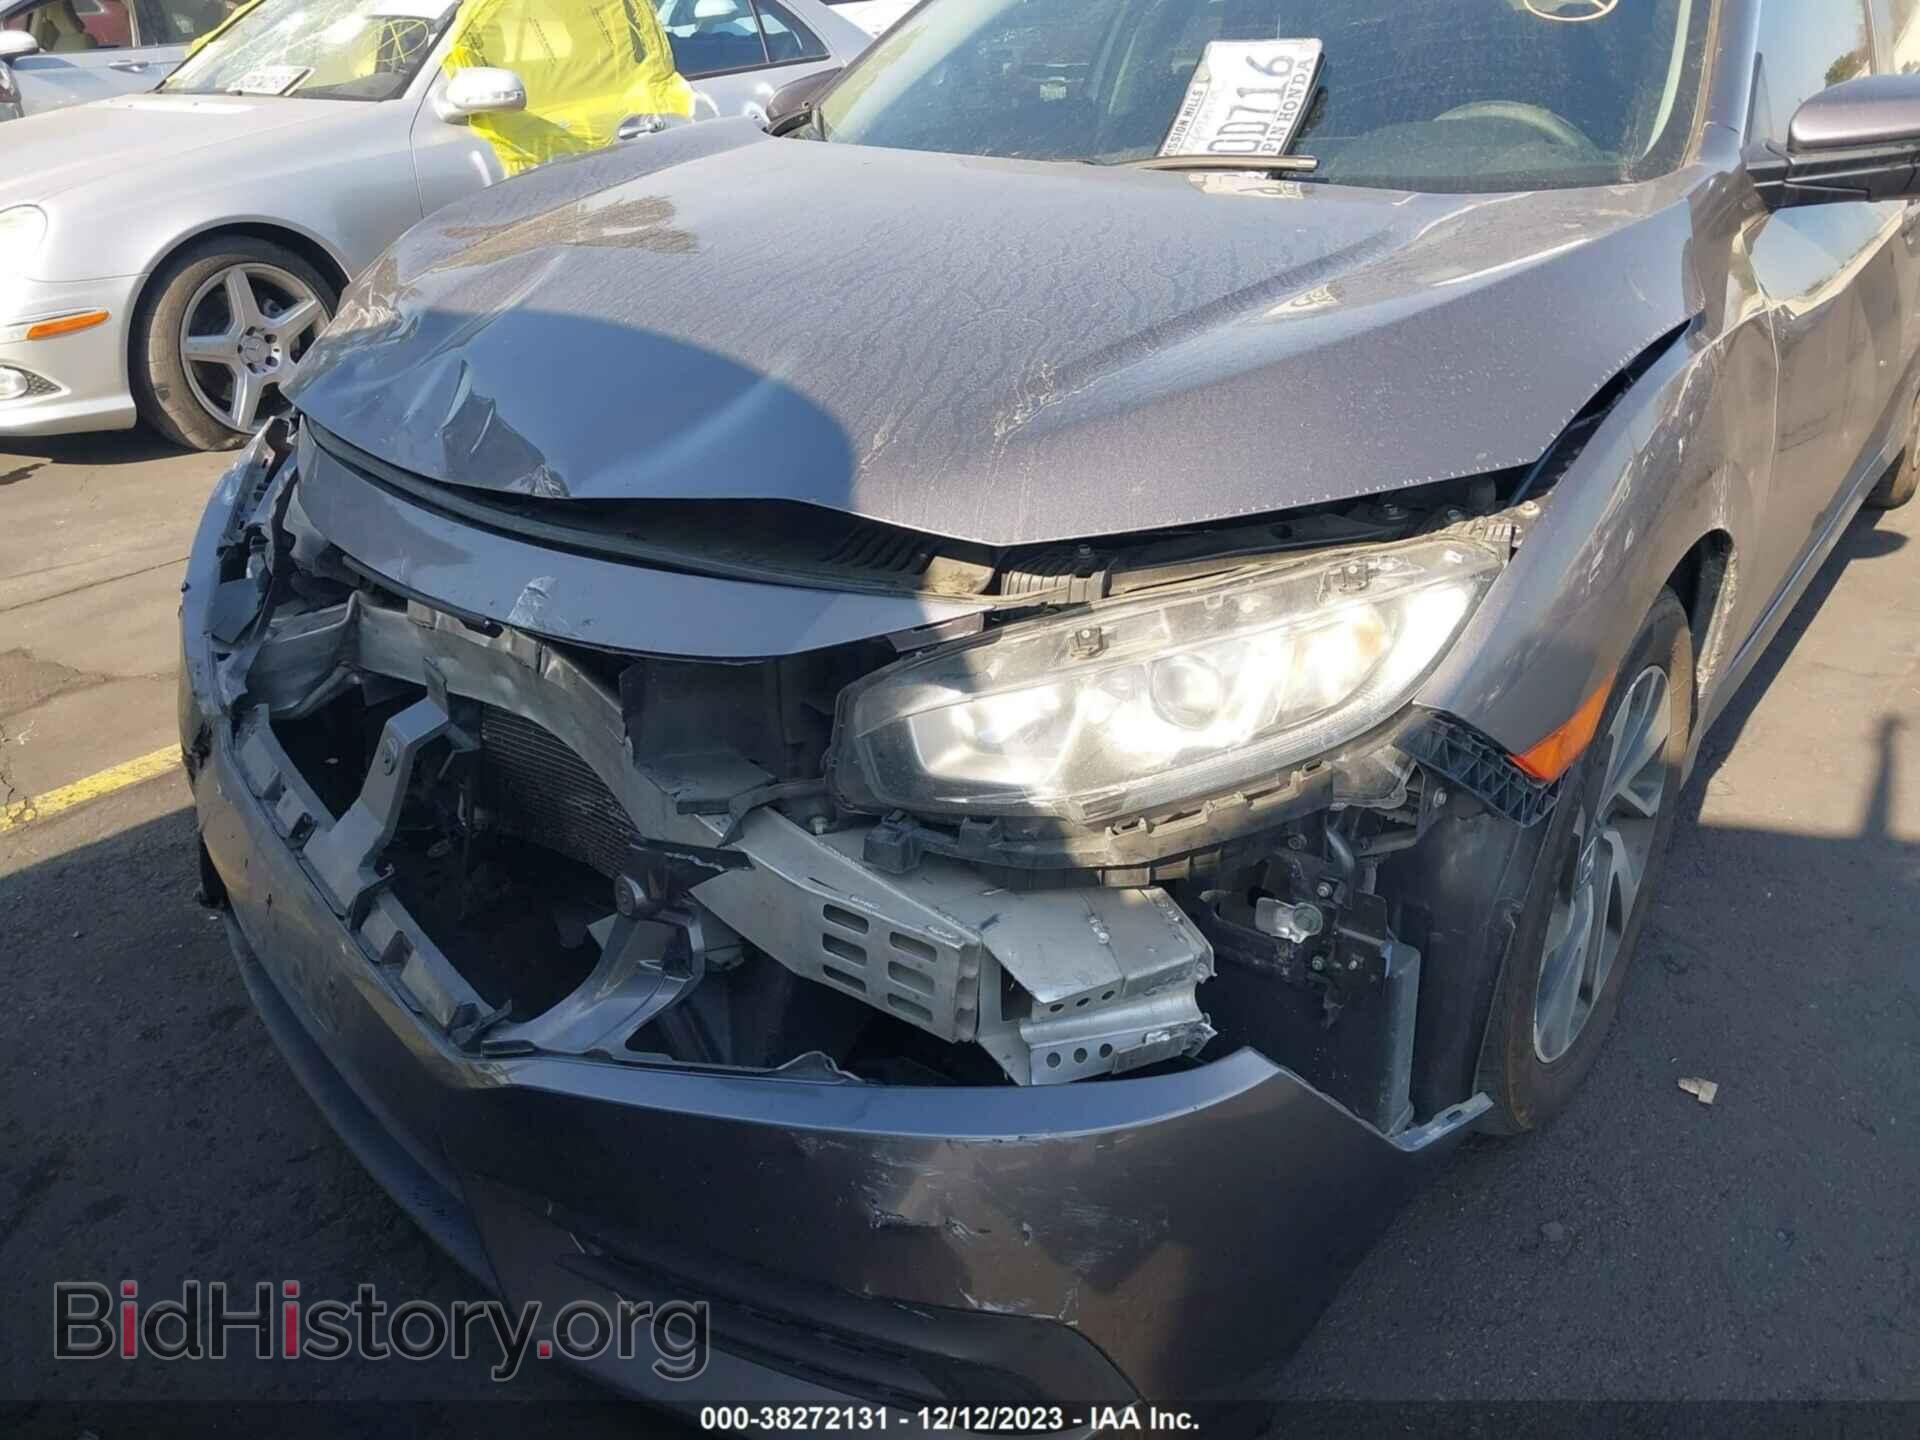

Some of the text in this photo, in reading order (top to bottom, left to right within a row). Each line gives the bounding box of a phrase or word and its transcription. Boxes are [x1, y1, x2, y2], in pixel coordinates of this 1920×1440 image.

[1184, 89, 1204, 117] HILLS
[1207, 55, 1295, 152] OD716
[1261, 56, 1315, 152] PIN HONDA
